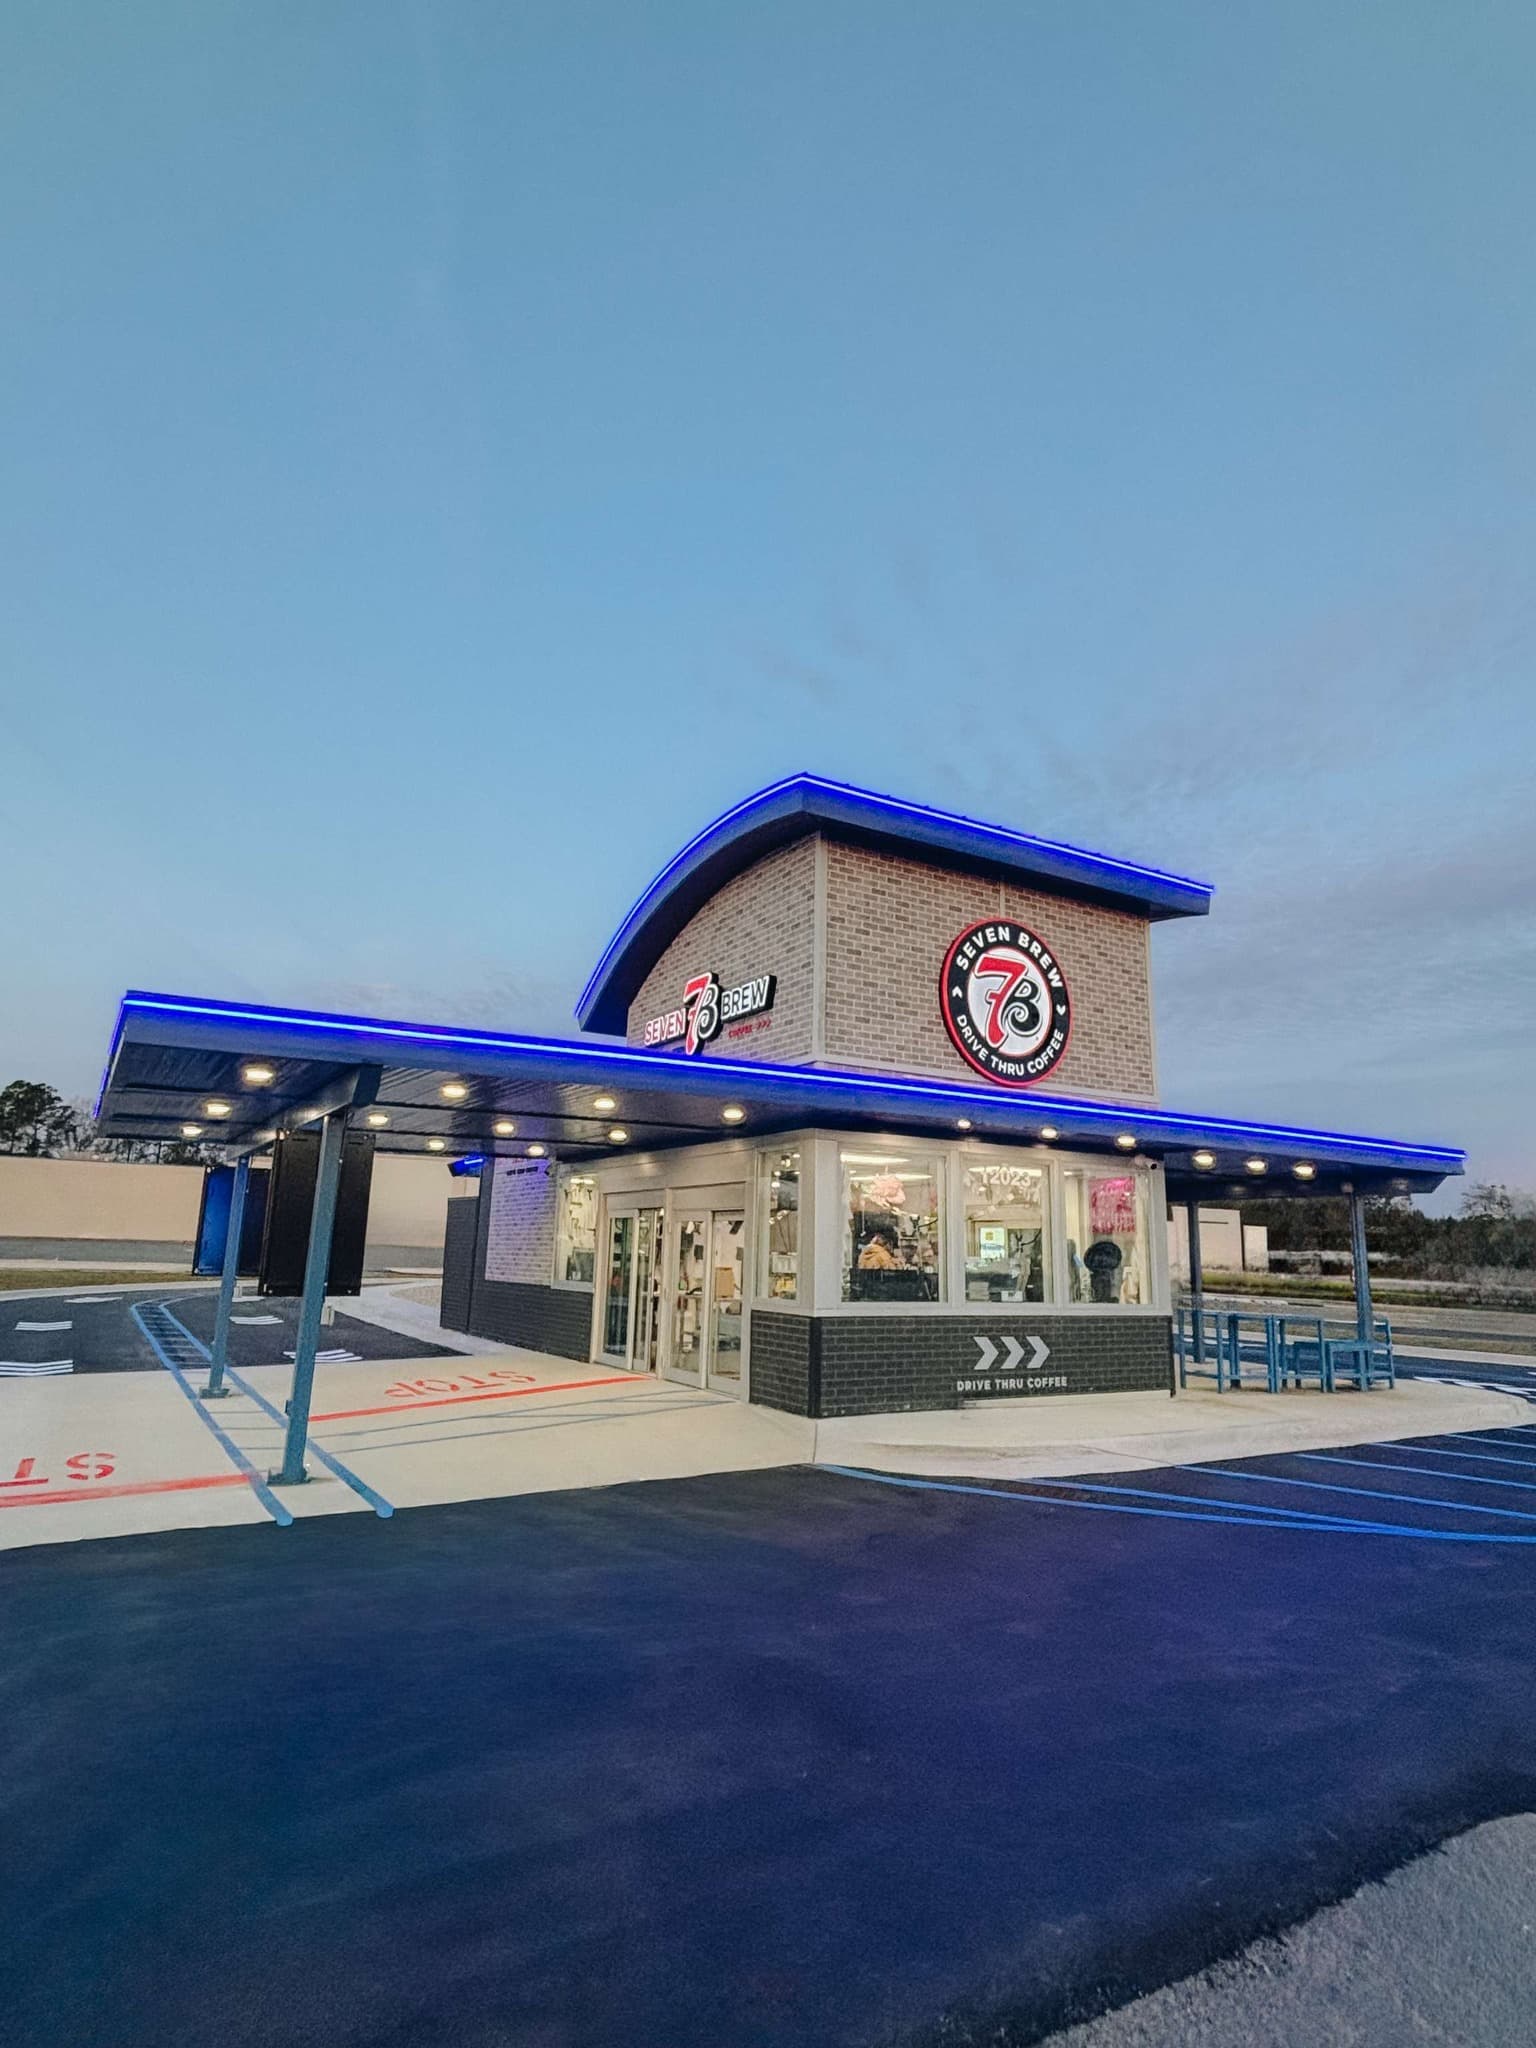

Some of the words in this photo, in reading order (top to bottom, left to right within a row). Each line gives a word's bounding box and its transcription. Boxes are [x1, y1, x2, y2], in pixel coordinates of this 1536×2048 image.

[956, 926, 1010, 970] SEVEN
[1018, 932, 1063, 988] BREW
[644, 1008, 686, 1046] SEVEN
[720, 975, 770, 1020] BREW
[957, 1014, 990, 1061] DRIVE
[990, 1055, 1025, 1076] THRU
[1027, 1028, 1064, 1074] COFFEE
[384, 1370, 536, 1397] STOP
[956, 1379, 992, 1391] DRIVE
[994, 1378, 1024, 1390] THRU
[1027, 1376, 1068, 1389] COFFEE
